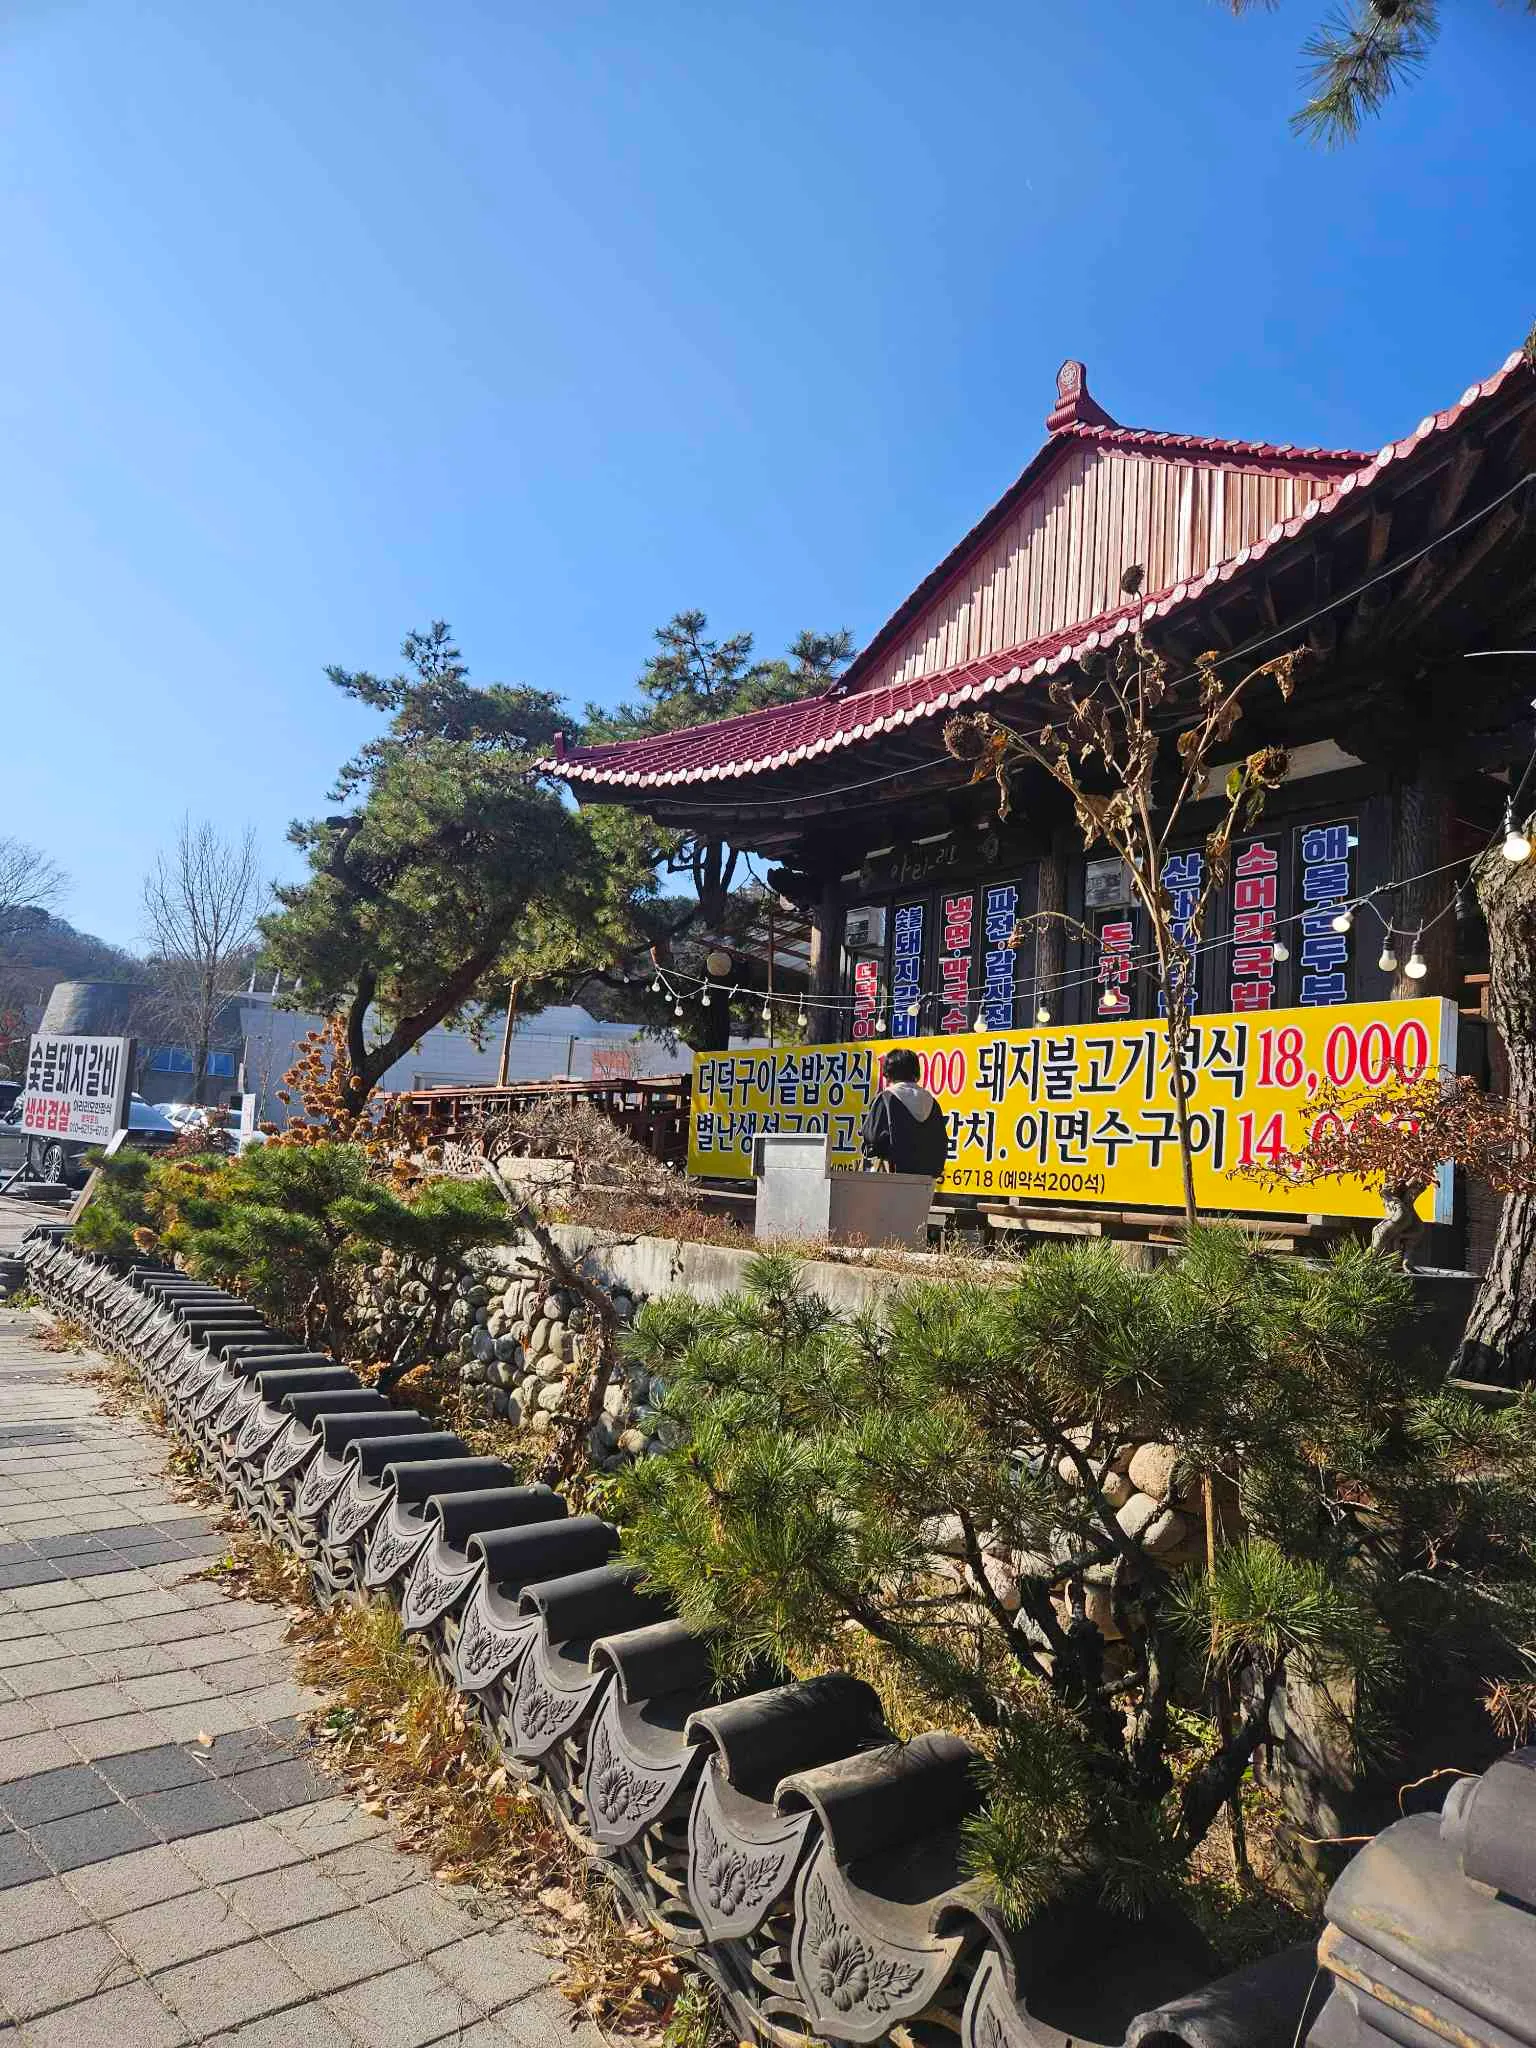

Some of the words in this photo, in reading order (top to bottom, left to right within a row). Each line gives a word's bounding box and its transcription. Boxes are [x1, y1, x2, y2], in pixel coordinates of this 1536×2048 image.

[1231, 842, 1278, 1012] 소머리국밥
[1300, 825, 1349, 1006] 해물순두부
[853, 960, 878, 1038] 더덕구이
[892, 905, 923, 1038] 숯불돼지갈비
[27, 1041, 119, 1098] 숯불돼지갈비
[699, 1050, 873, 1107] 더덕구이솥밥정식
[976, 1024, 1247, 1103] 돼지불고기정식
[1258, 1021, 1429, 1097] 18,000
[24, 1097, 71, 1133] 생삼겹살
[1015, 1108, 1226, 1170] 이면수구이
[999, 1171, 1105, 1194] (예약석200석)
